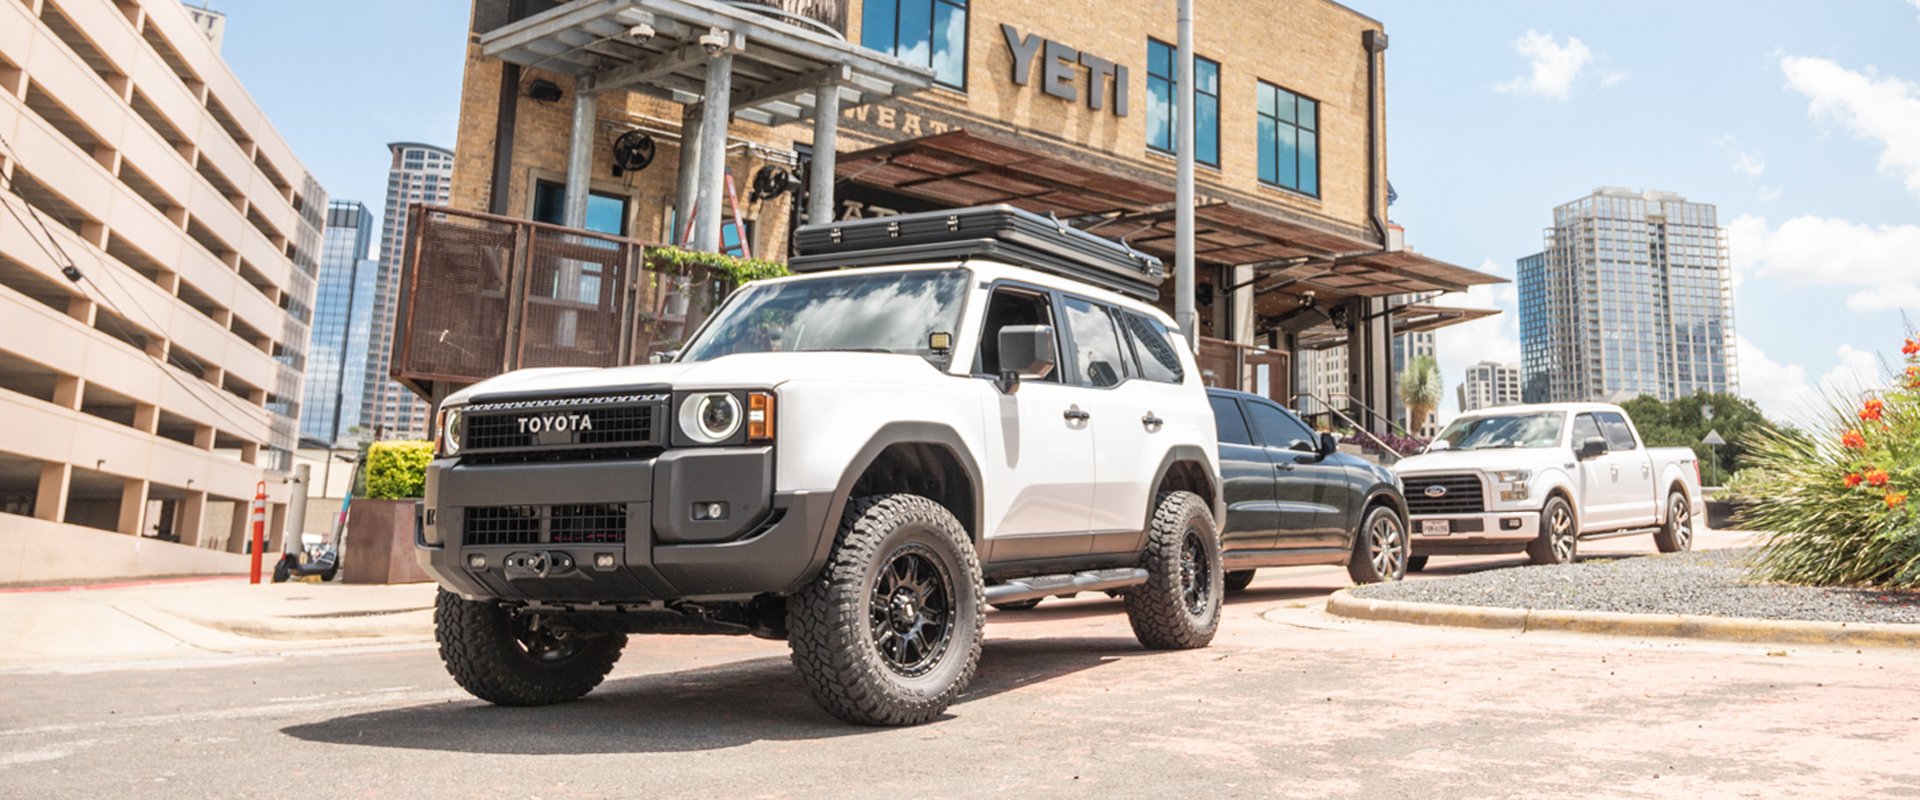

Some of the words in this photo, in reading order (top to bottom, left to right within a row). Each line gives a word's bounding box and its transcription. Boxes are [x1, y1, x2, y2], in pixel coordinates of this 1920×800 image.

[999, 23, 1128, 118] YETI
[843, 104, 964, 137] WEAT
[517, 414, 592, 434] TOYOTA
